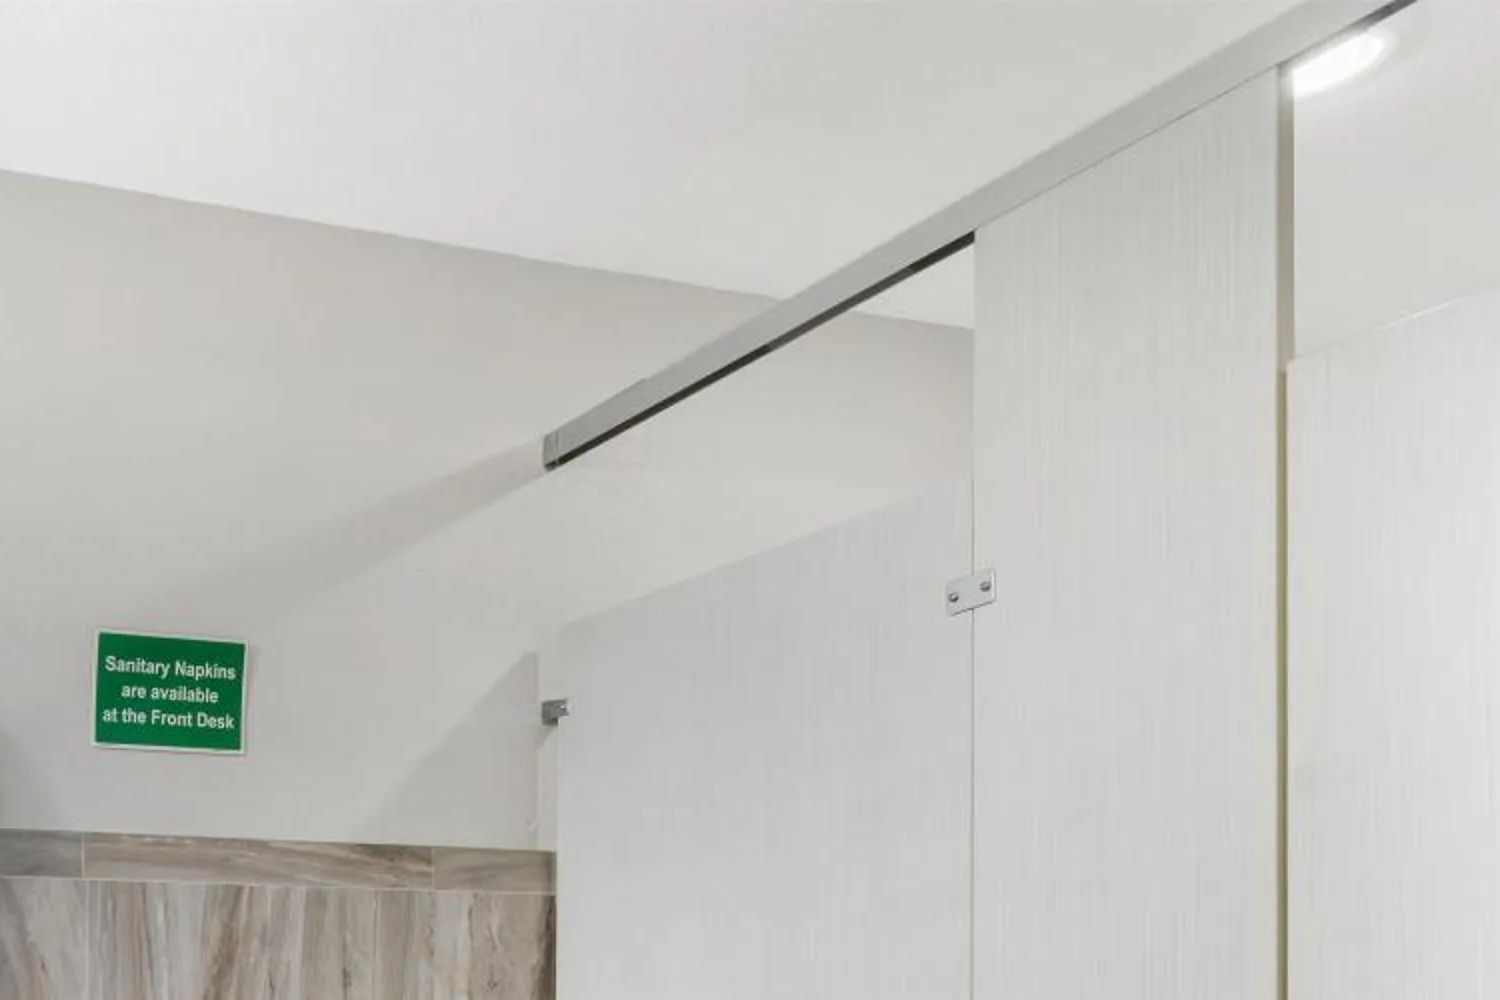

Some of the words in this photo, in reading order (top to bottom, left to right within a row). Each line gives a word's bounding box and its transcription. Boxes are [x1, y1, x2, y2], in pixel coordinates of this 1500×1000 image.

[104, 655, 170, 679] Sanitary
[175, 660, 237, 681] Napkins
[121, 685, 147, 699] are
[150, 686, 219, 703] available
[102, 708, 118, 723] at
[122, 708, 147, 724] the
[151, 709, 193, 727] Front
[197, 712, 235, 729] Desk
